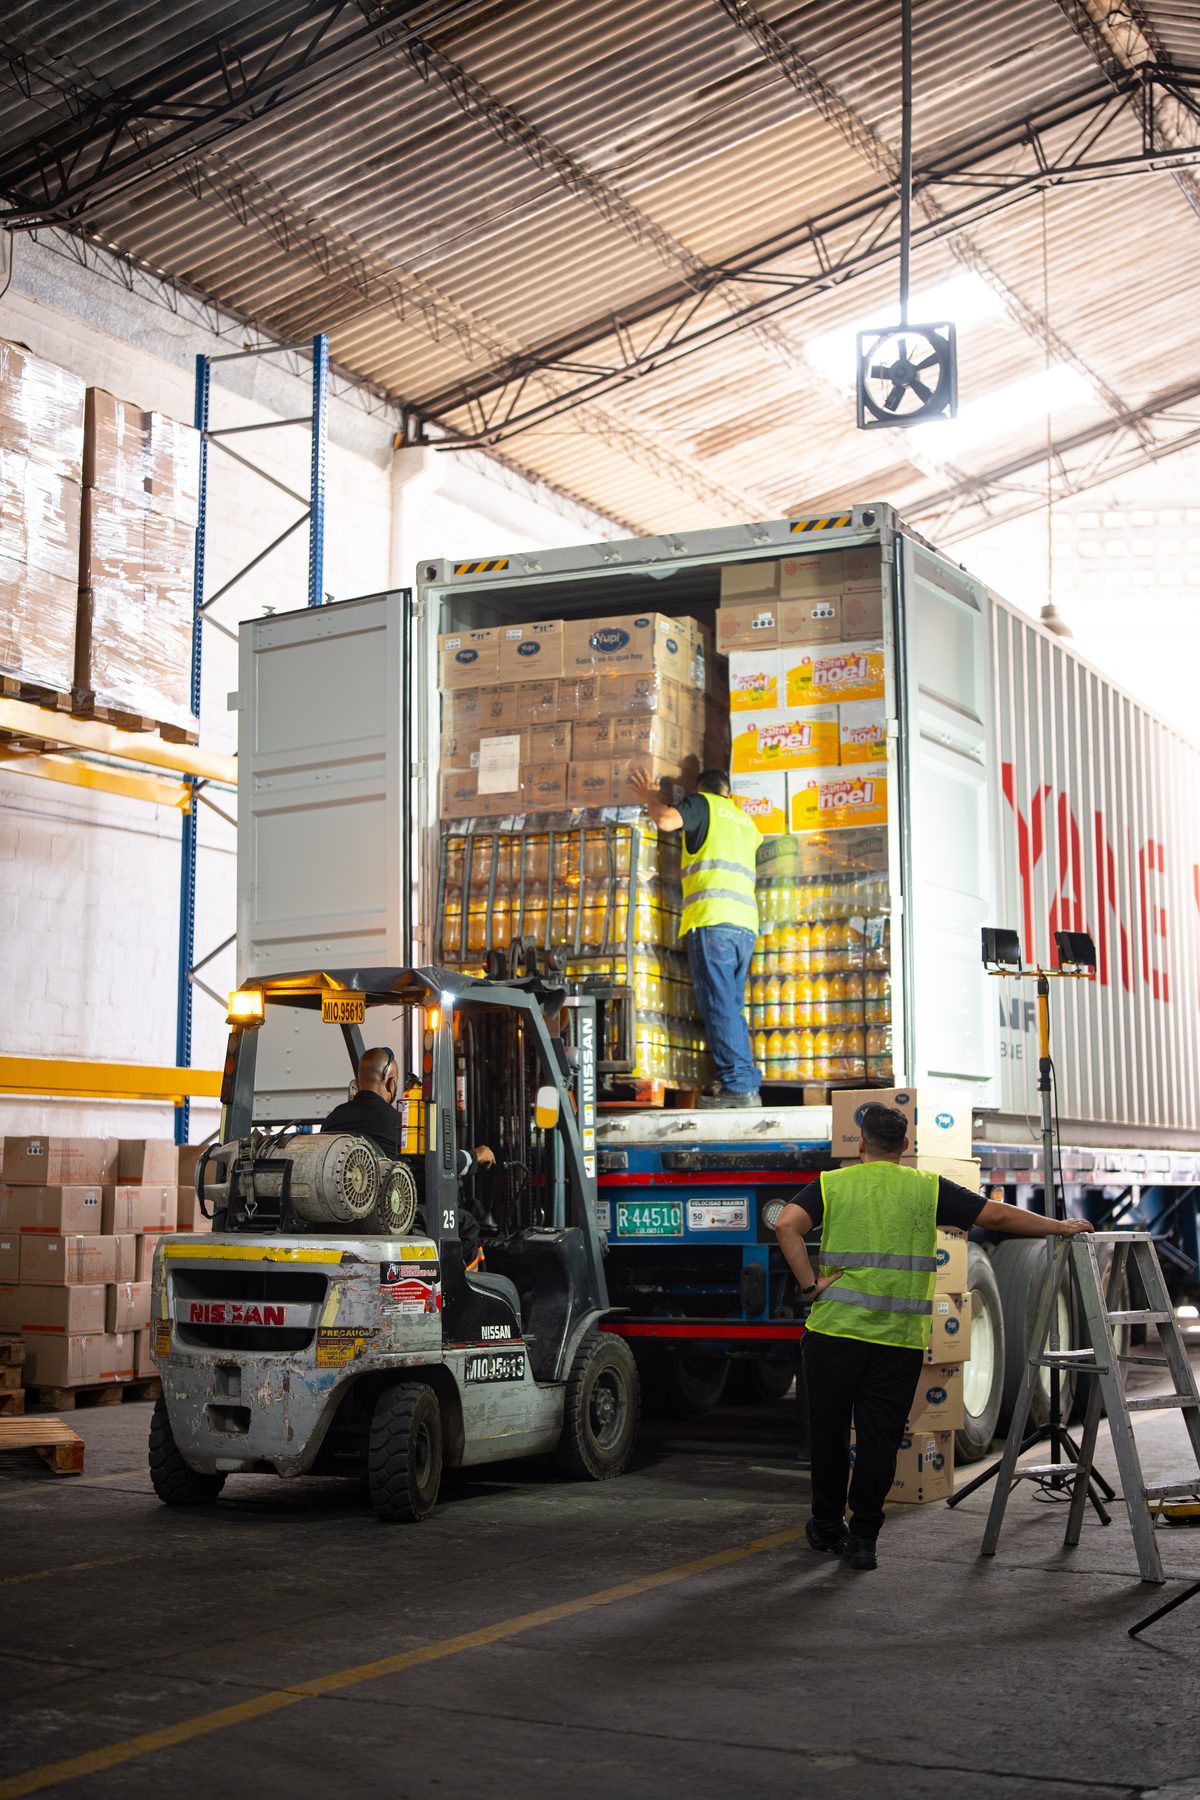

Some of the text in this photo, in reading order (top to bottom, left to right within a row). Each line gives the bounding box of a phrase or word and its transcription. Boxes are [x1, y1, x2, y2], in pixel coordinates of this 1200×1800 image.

[596, 632, 620, 644] Yupi
[814, 656, 868, 685] noel
[758, 726, 812, 753] noel
[820, 782, 873, 809] noel
[582, 1018, 594, 1102] NISSAN
[443, 1210, 455, 1229] 25
[619, 1208, 680, 1227] R-44510
[693, 1212, 703, 1220] 50
[733, 1212, 744, 1220] 80
[481, 1325, 511, 1340] NISSAN
